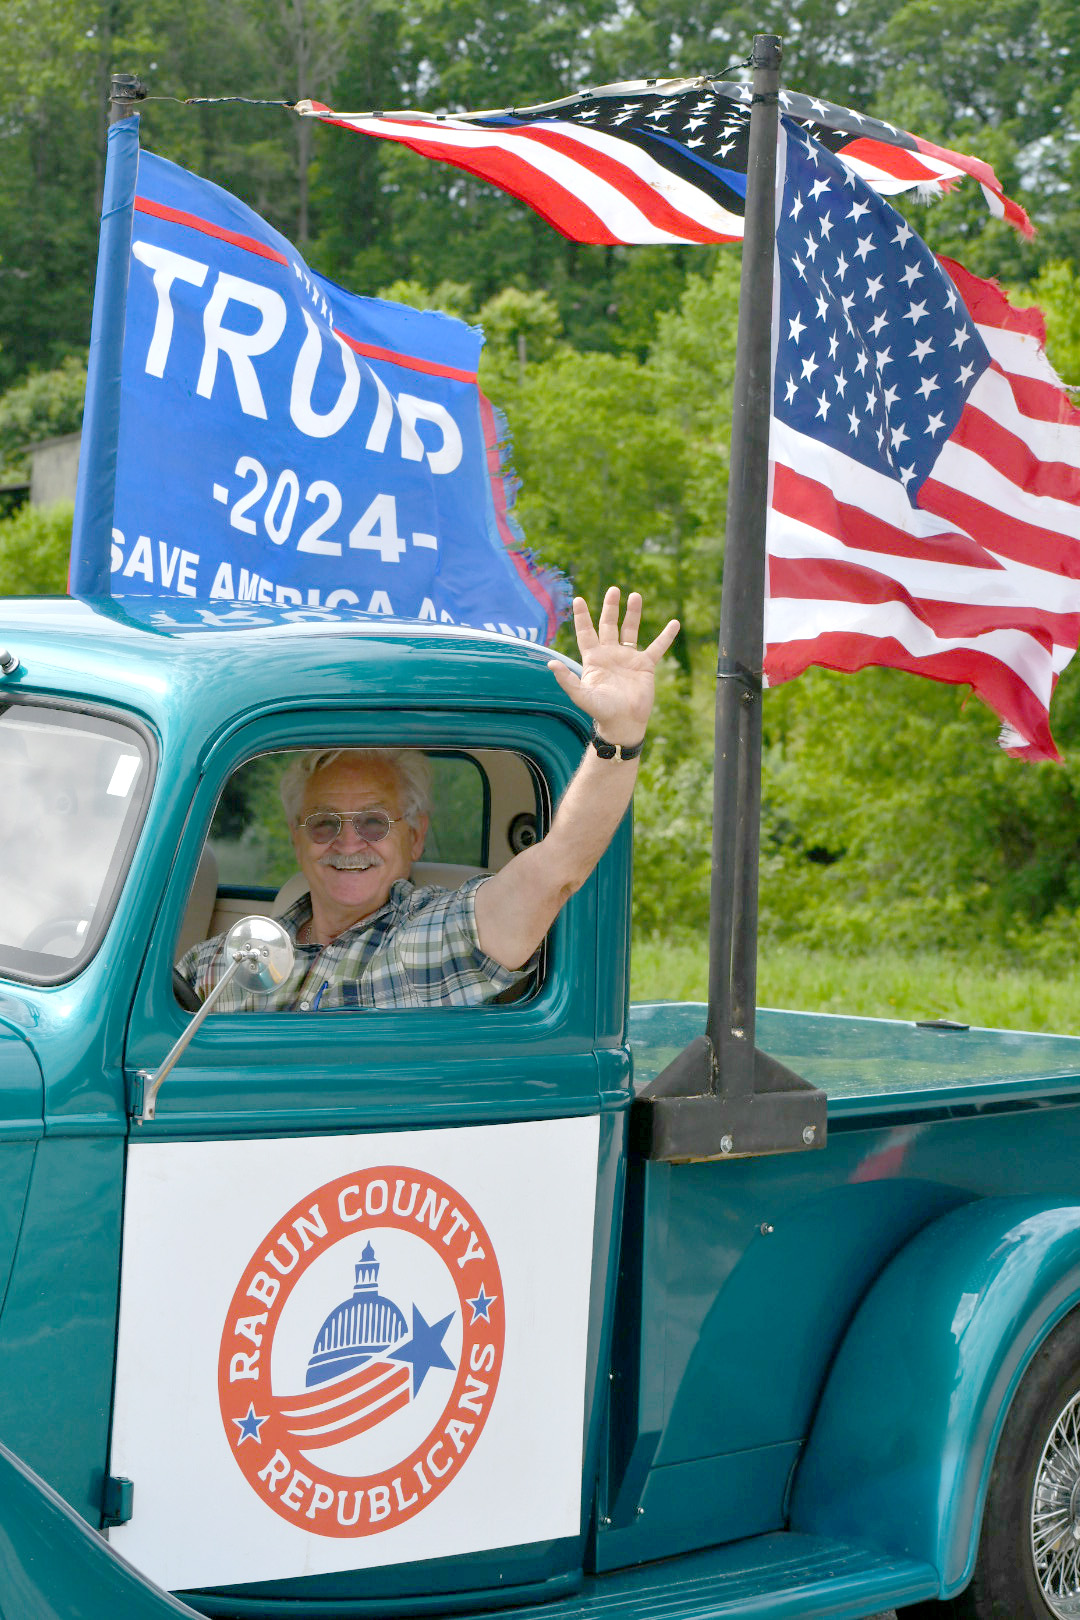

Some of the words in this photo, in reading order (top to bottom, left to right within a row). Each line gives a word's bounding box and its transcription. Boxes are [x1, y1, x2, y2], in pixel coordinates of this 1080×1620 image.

[110, 527, 201, 598] SAVE
[212, 455, 439, 563] -2024-
[229, 1203, 329, 1384] RABUN
[337, 1179, 486, 1269] COUNTY
[257, 1342, 495, 1526] REPUBLICANS
